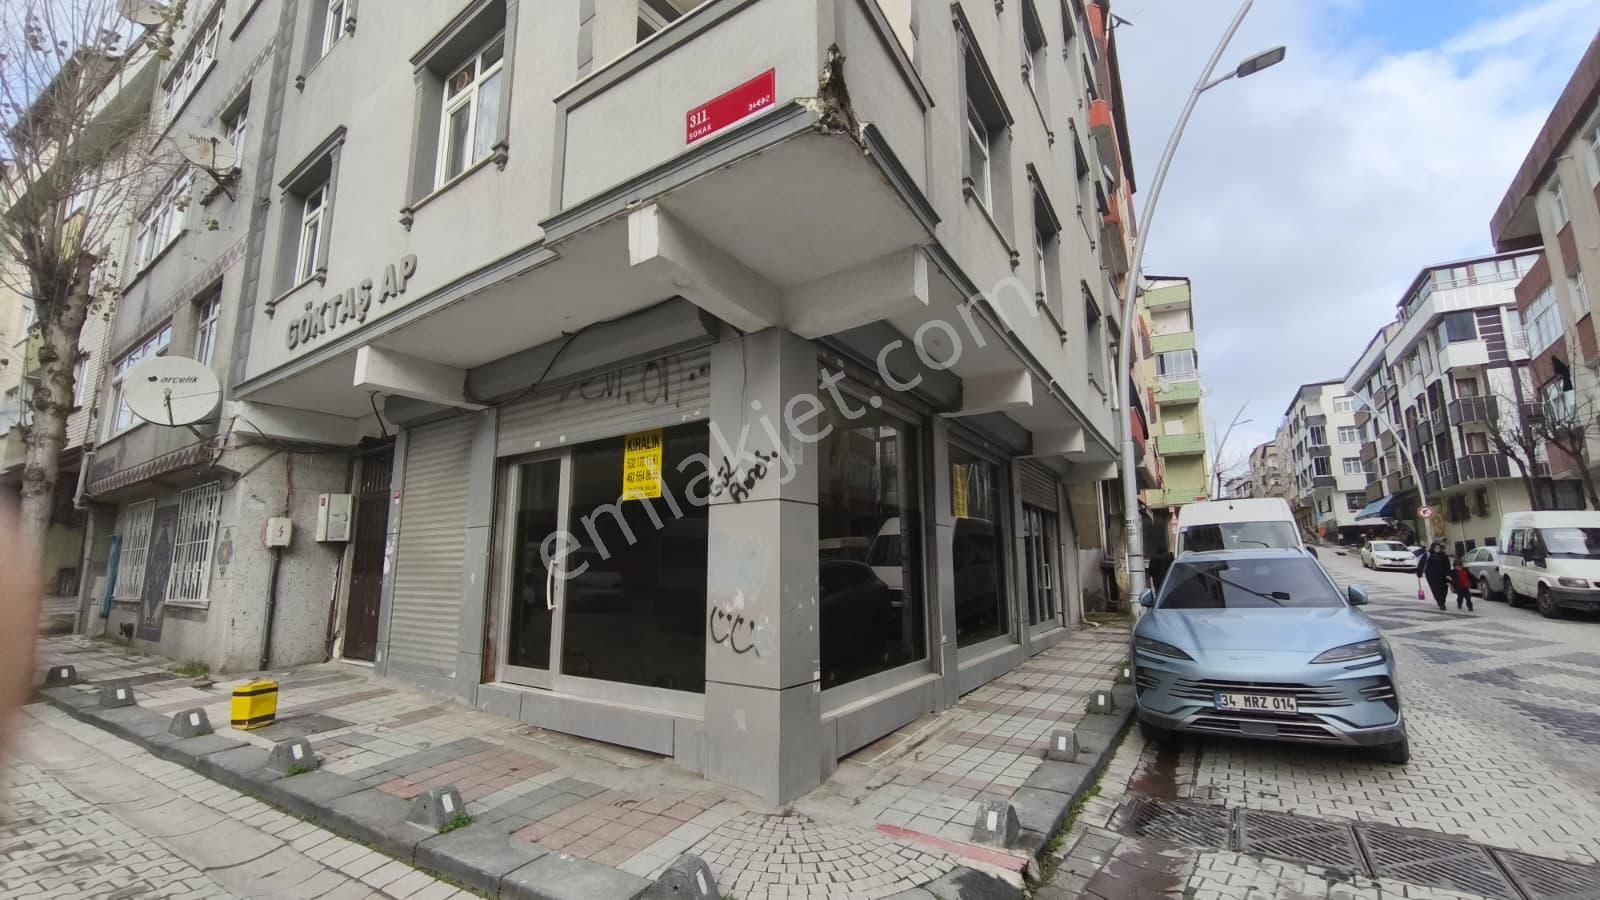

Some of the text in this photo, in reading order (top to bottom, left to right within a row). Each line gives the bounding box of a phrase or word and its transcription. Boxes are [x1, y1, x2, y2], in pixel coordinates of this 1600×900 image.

[690, 109, 711, 128] 311.
[689, 120, 712, 140] SOKAK
[286, 254, 418, 350] GÖKTAŞ AP
[1221, 694, 1294, 710] 34 MRZ 014
